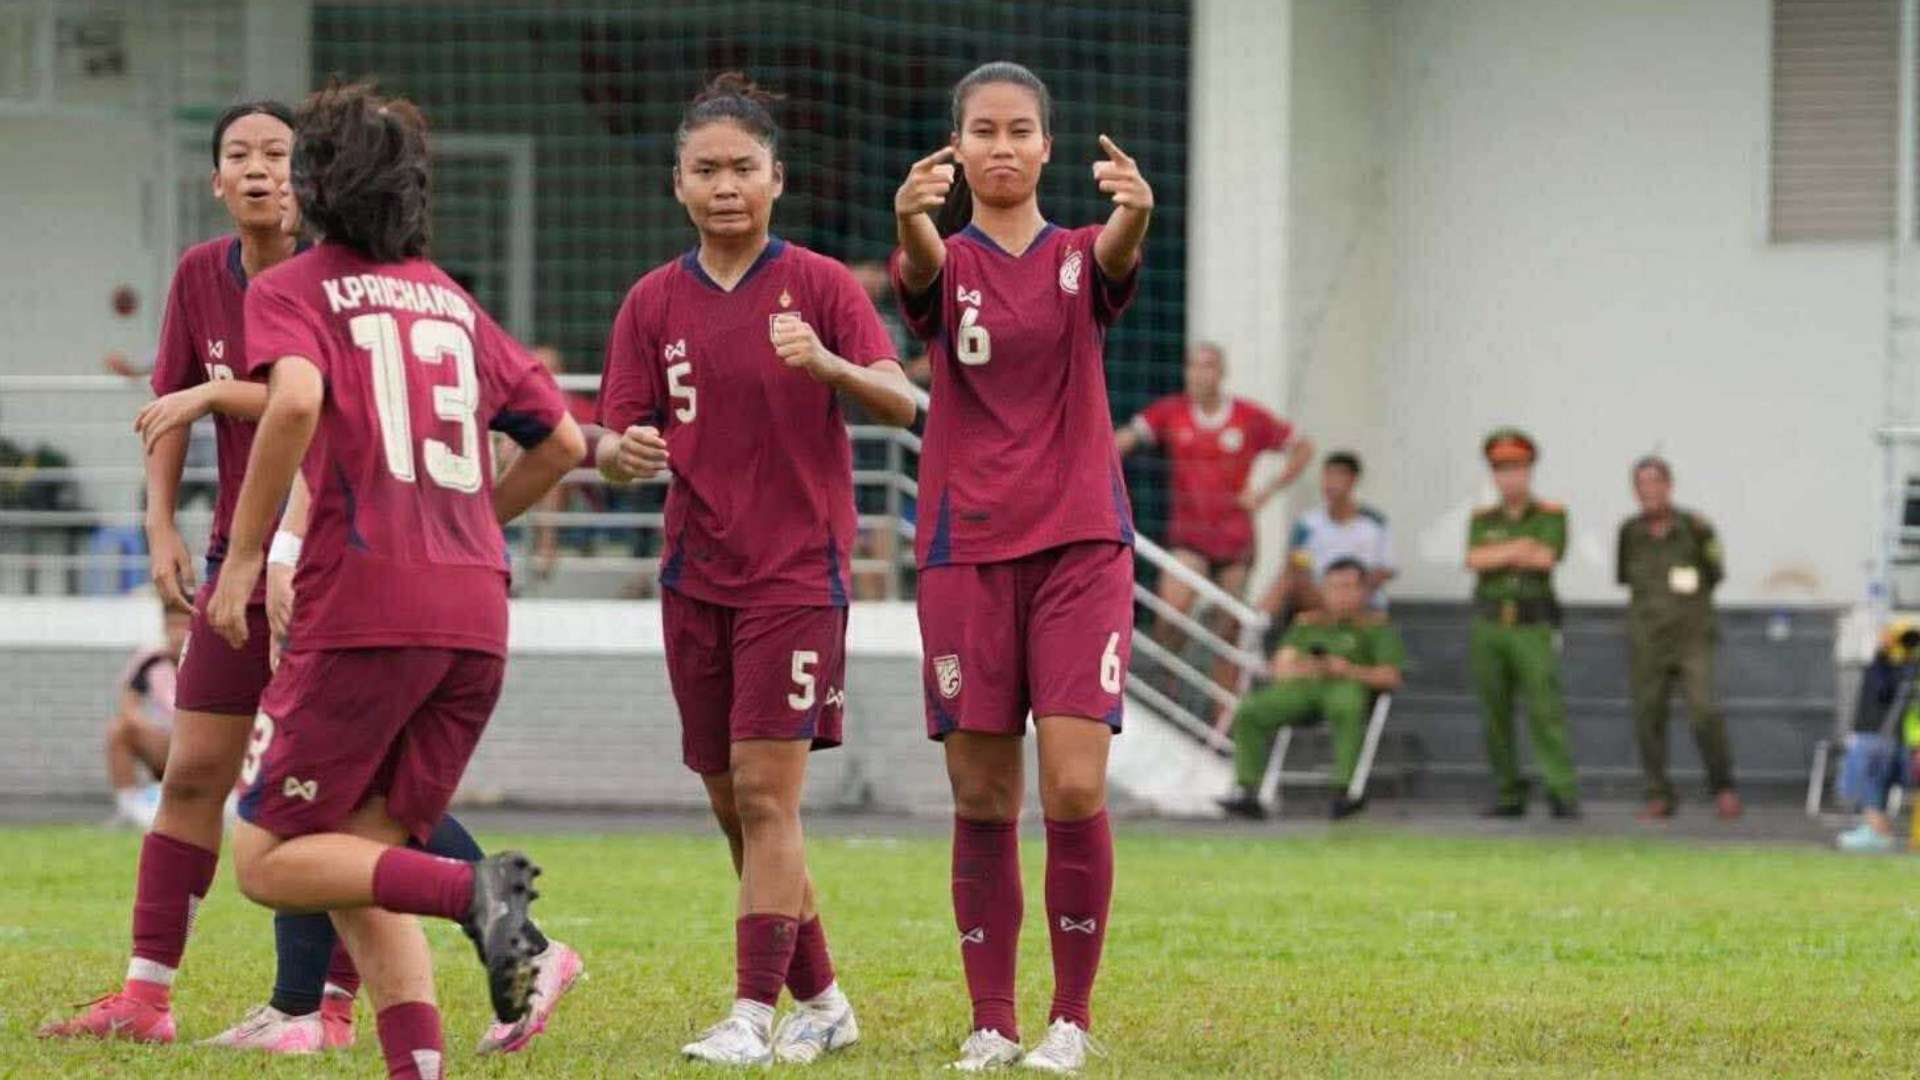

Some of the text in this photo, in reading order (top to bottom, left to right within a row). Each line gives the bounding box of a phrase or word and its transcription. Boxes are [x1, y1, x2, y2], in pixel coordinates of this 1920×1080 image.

[957, 306, 991, 365] 6
[350, 313, 483, 493] 13
[666, 361, 697, 423] 5
[788, 650, 818, 710] 5
[1101, 632, 1121, 694] 6
